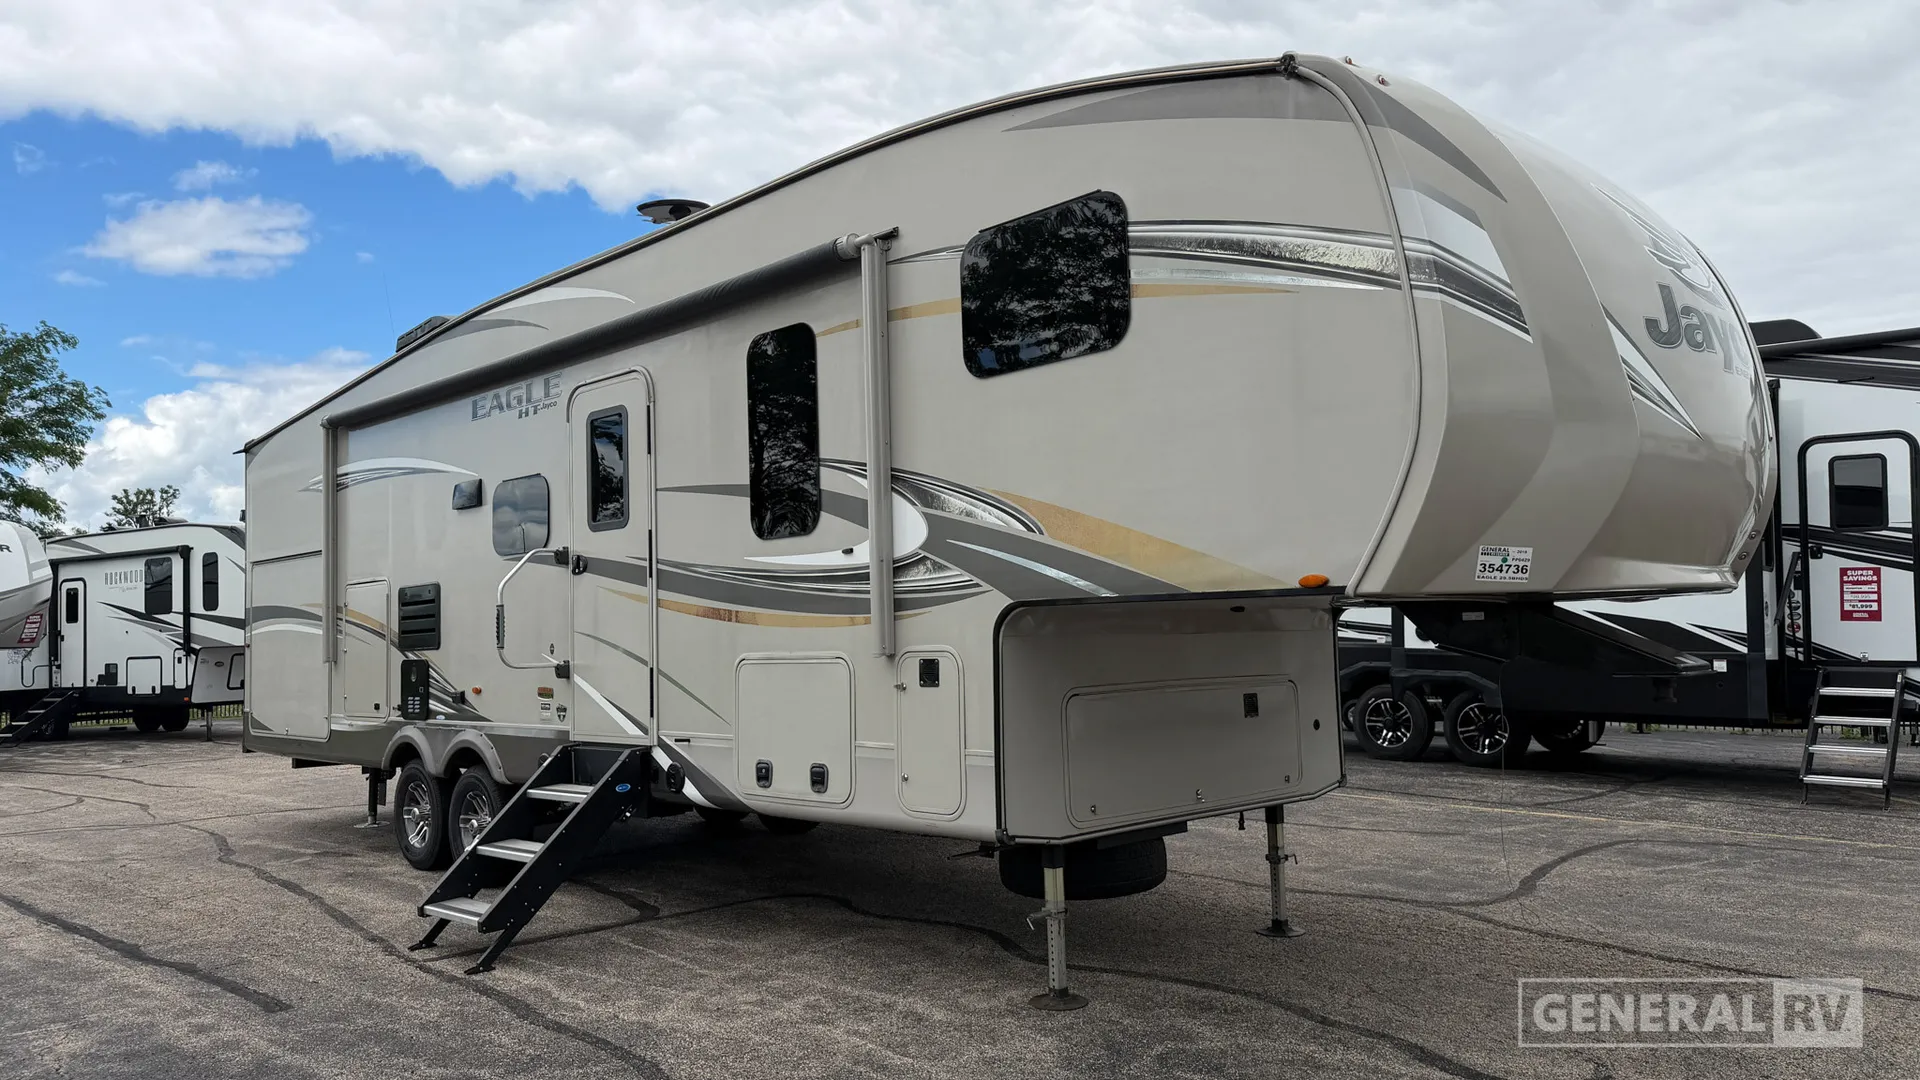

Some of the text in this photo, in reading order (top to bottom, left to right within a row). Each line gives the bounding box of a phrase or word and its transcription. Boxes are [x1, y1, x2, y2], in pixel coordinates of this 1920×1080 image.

[471, 371, 563, 422] EAGLE
[518, 404, 541, 420] HT
[1479, 563, 1528, 574] 354736
[104, 569, 144, 585] ROCKWOOD
